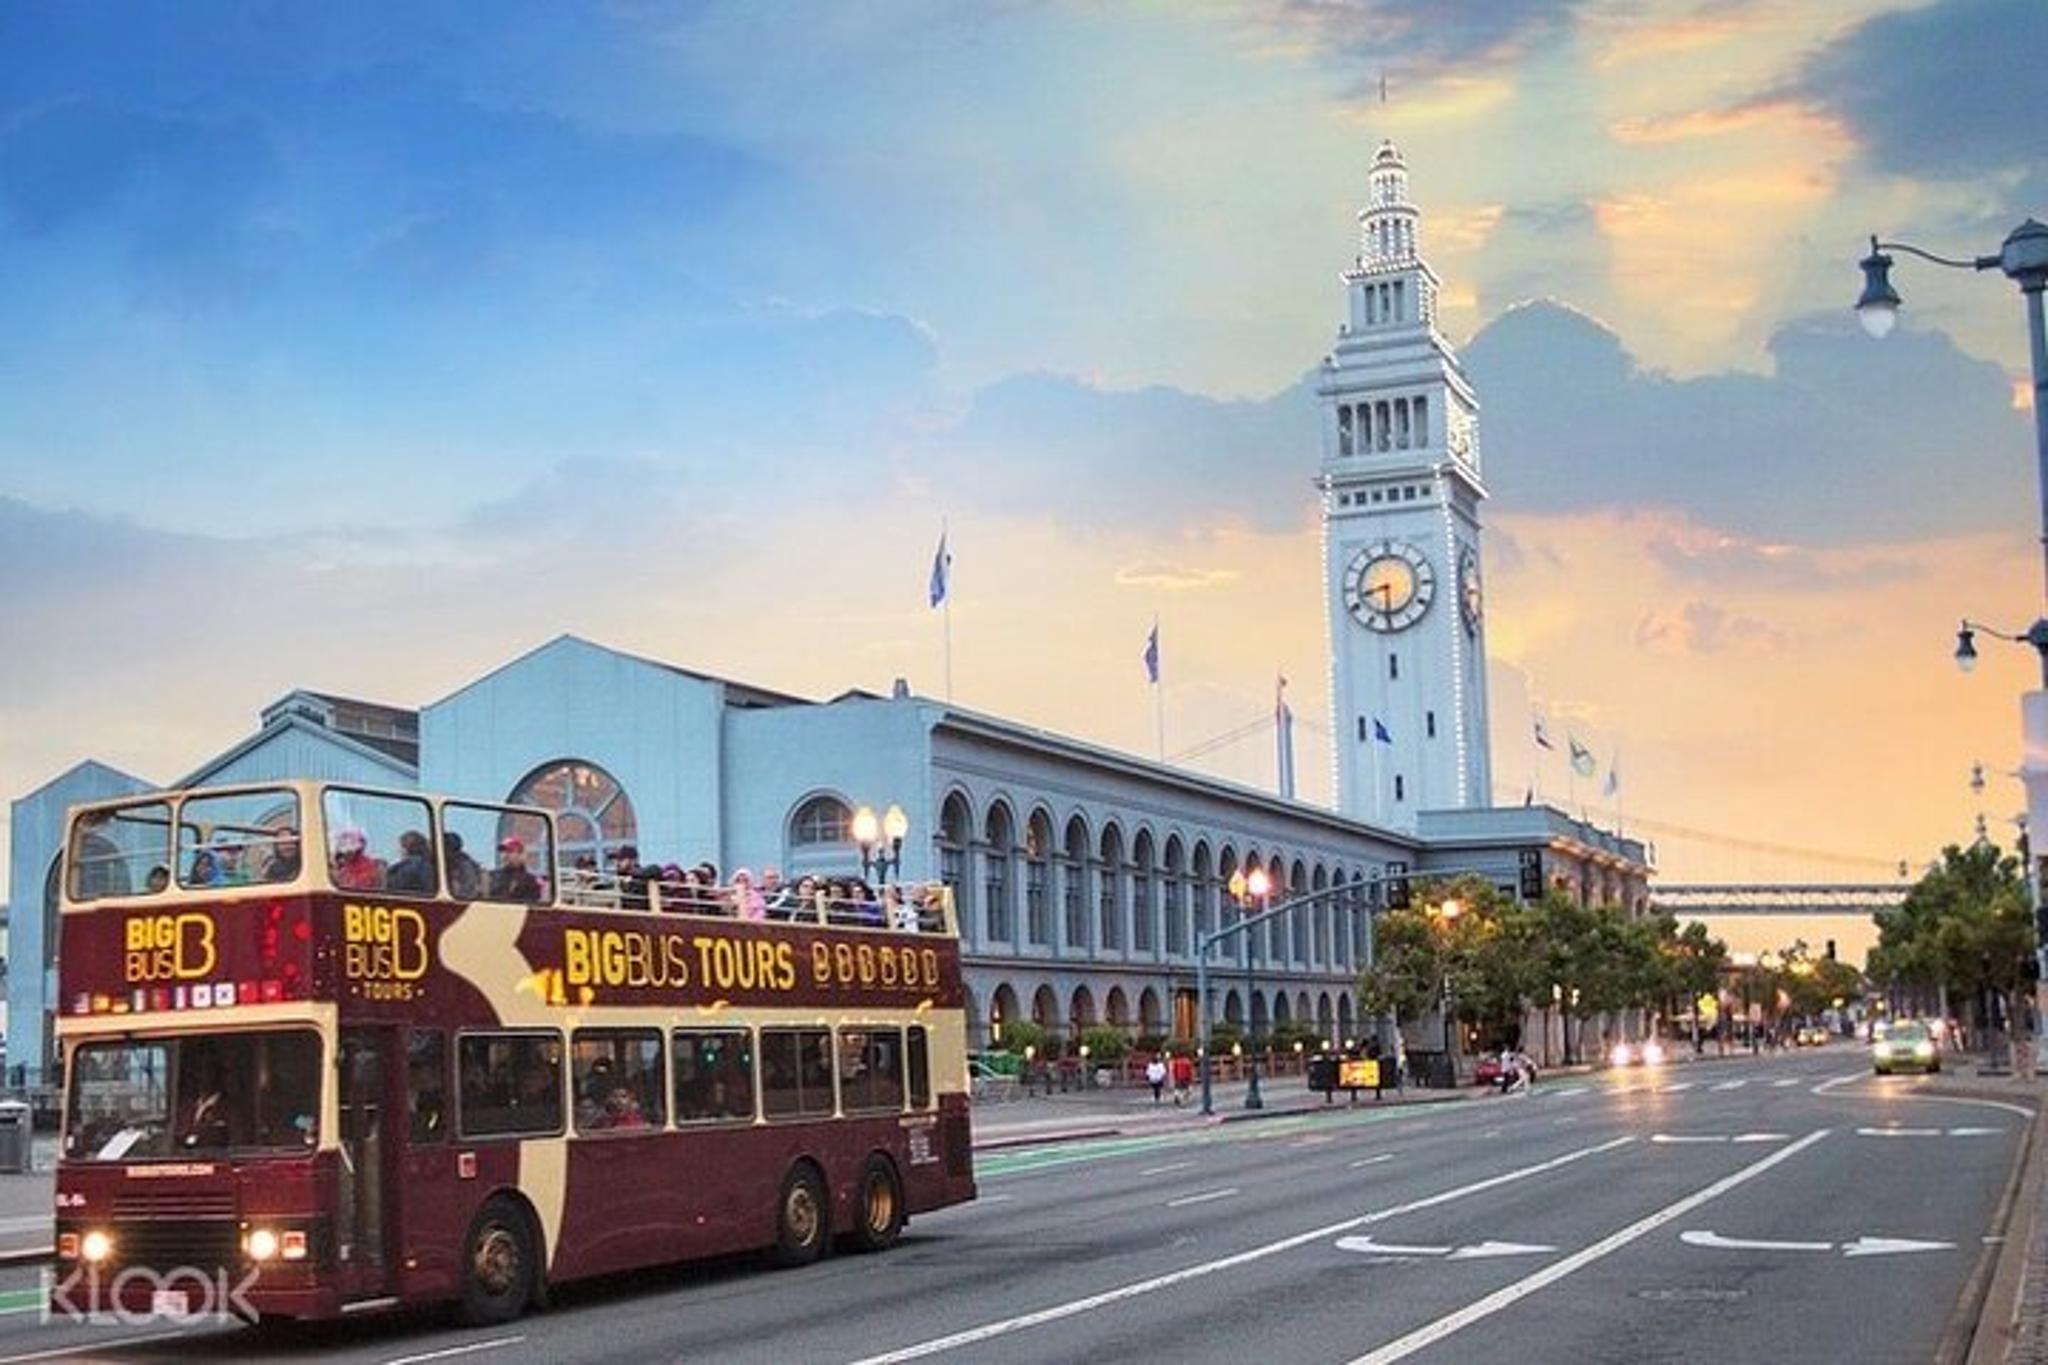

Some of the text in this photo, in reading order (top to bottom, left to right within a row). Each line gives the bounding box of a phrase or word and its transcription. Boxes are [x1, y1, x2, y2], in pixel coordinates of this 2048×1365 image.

[126, 914, 175, 950] BIG
[344, 904, 391, 942] BIG
[126, 950, 175, 982] BUS
[346, 943, 391, 979] BUS
[693, 937, 796, 990] TOURS
[363, 981, 413, 1000] TOURS
